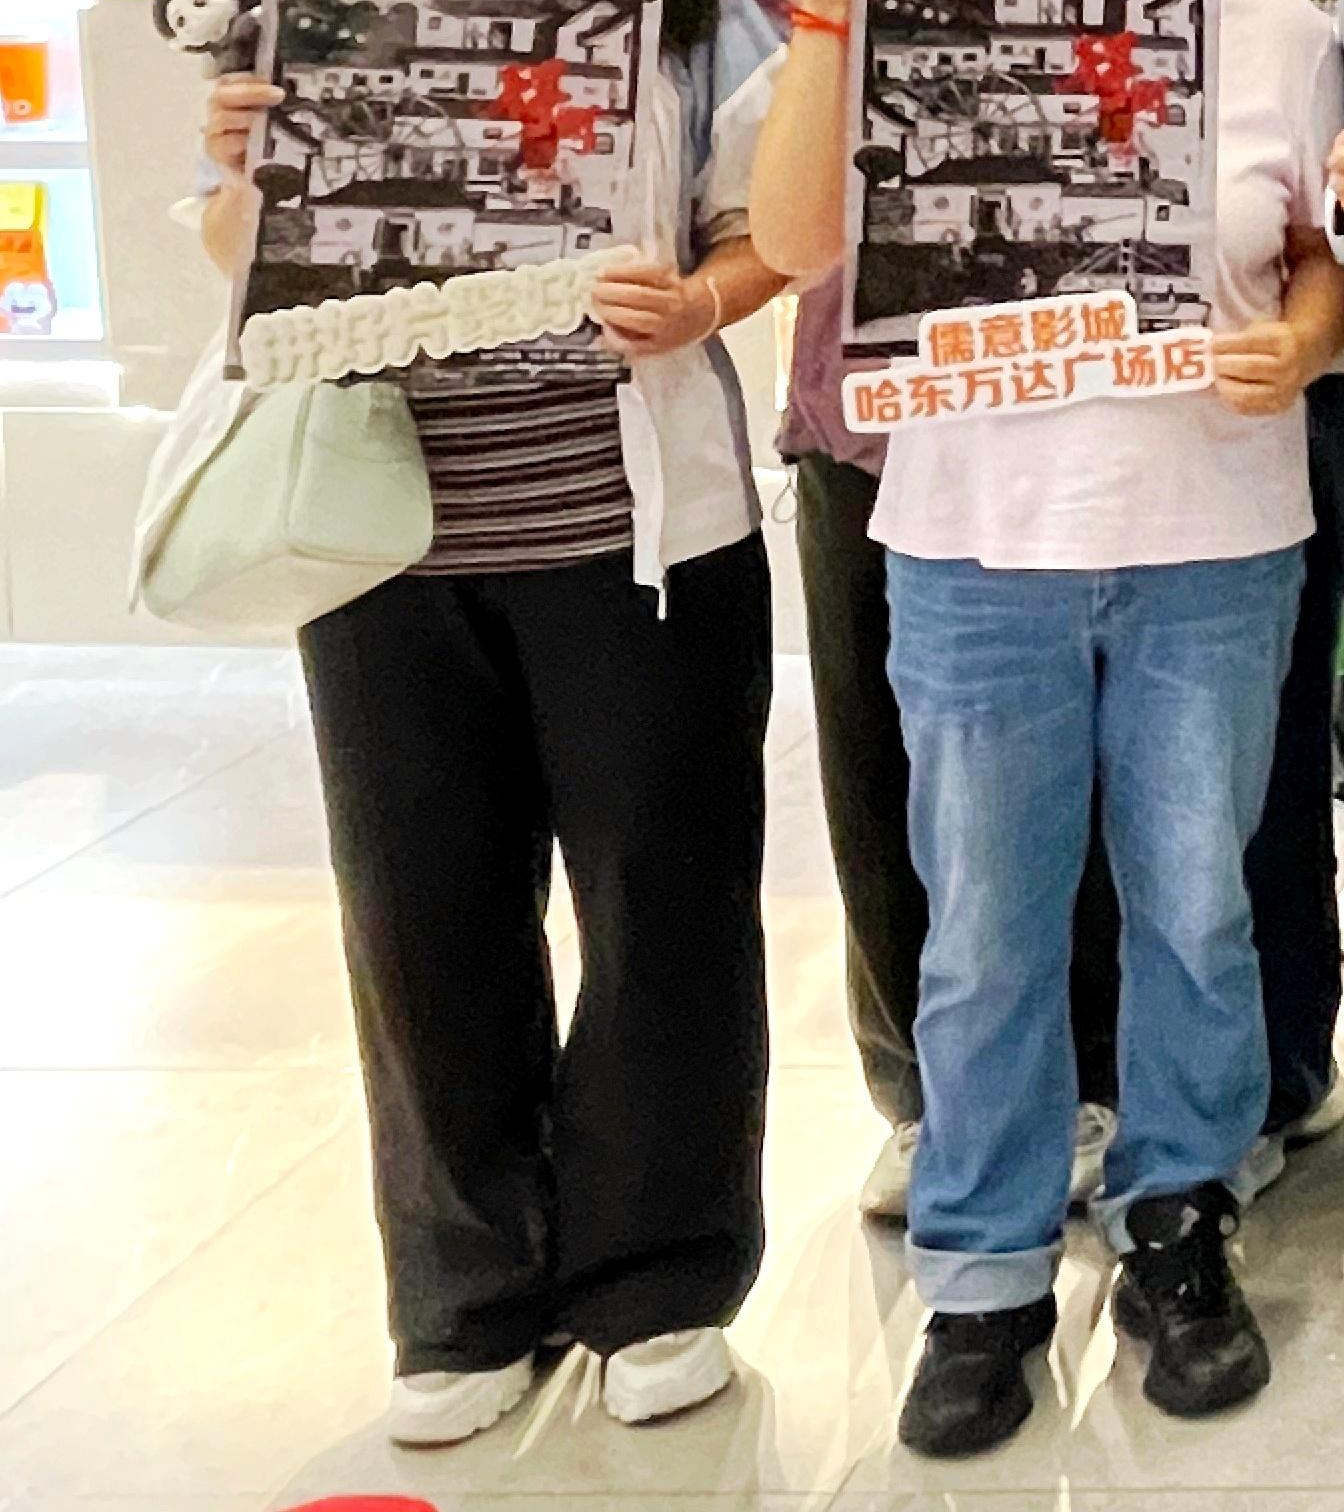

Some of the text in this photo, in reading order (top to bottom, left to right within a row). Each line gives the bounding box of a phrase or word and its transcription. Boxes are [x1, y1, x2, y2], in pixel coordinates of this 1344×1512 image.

[928, 299, 1129, 368] 儒意影城
[854, 338, 1207, 424] 哈东万达广场店
